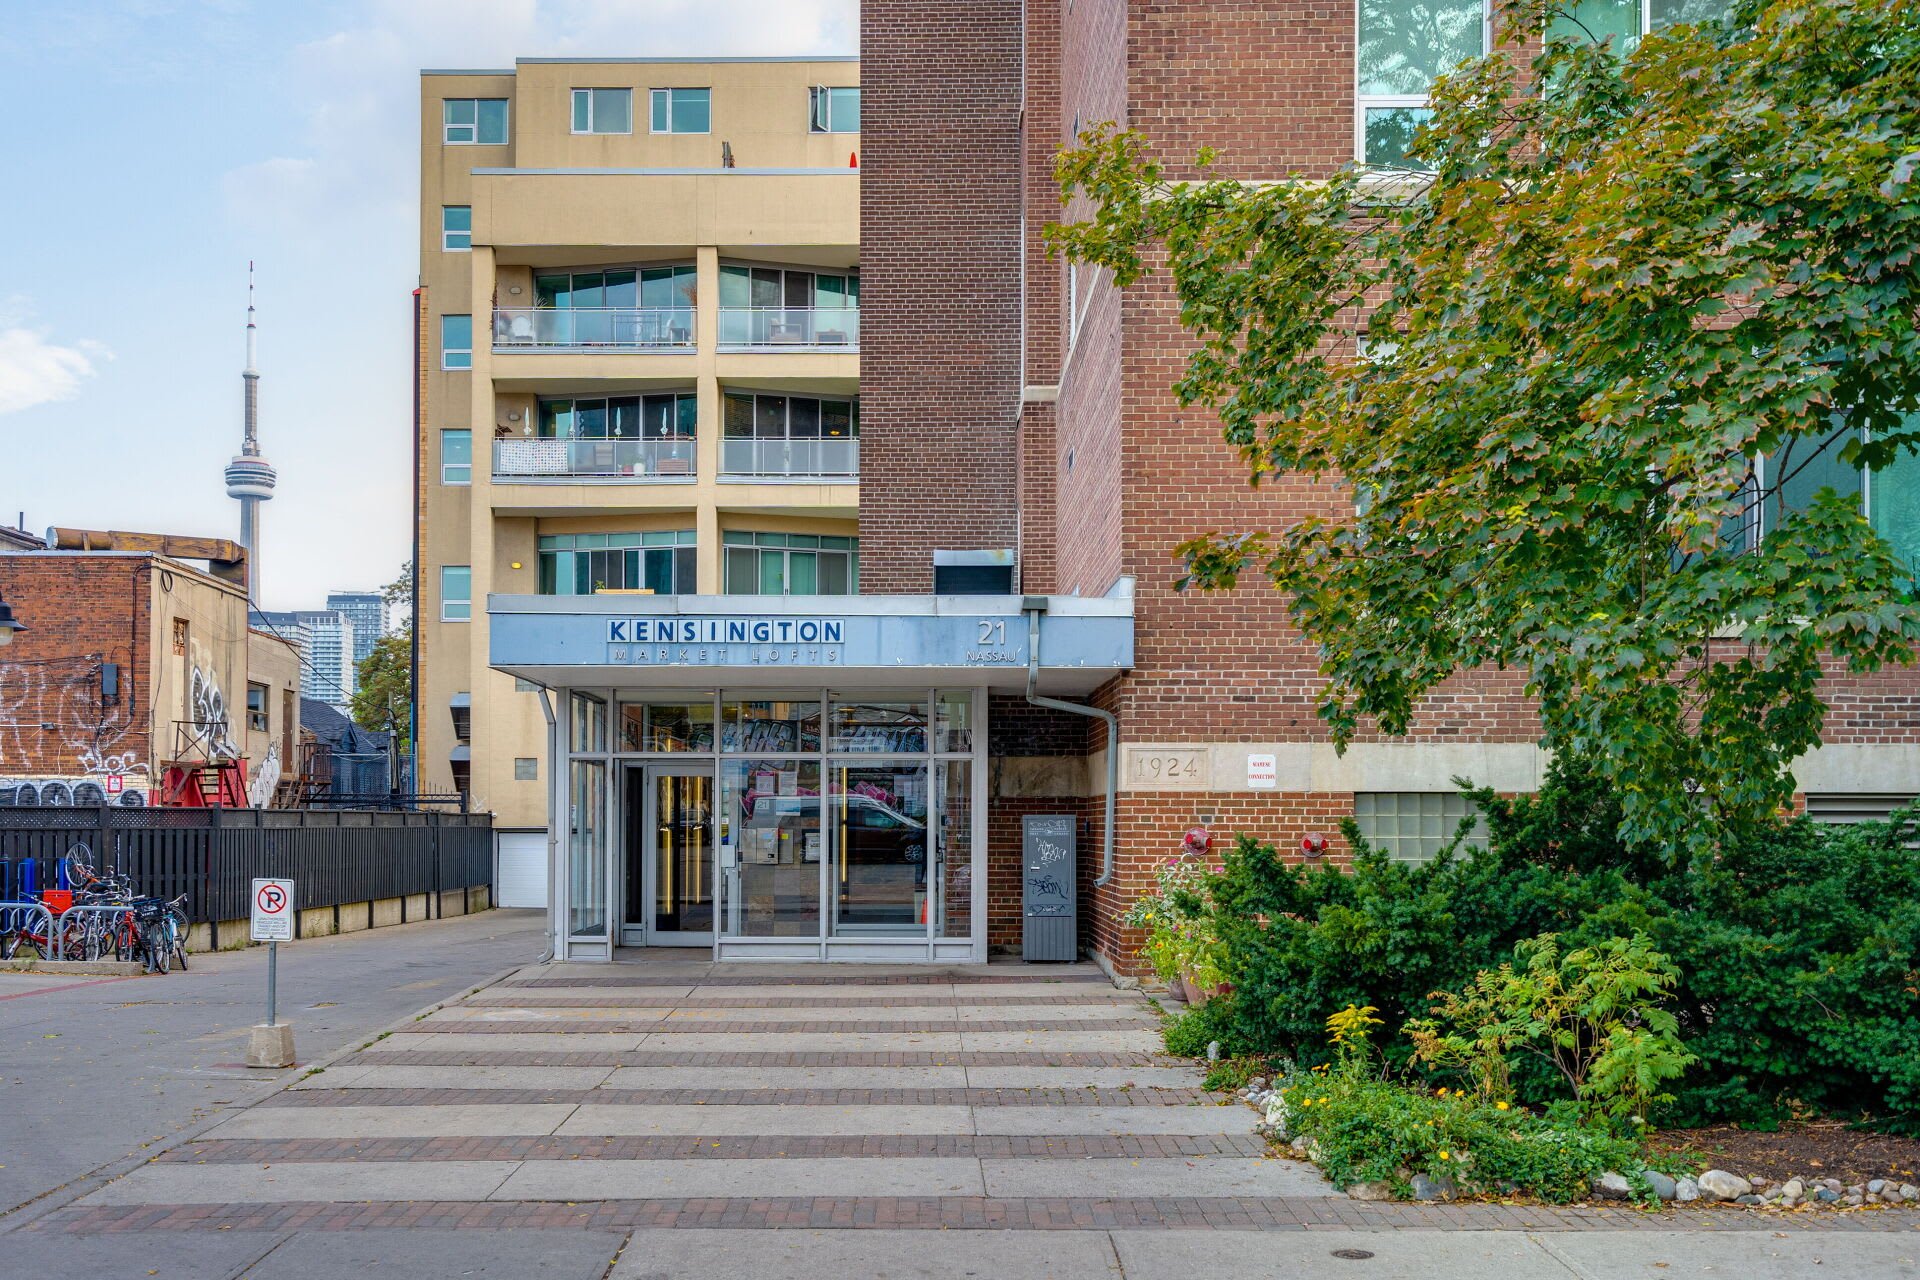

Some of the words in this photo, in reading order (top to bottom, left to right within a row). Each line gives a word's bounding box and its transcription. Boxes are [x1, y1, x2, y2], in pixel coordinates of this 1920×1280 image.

[610, 621, 842, 642] KENSINGTON
[977, 620, 1006, 645] 21
[615, 649, 727, 661] MARKET
[752, 649, 837, 661] LOFTS
[966, 650, 1016, 662] NASSAU
[1137, 757, 1197, 778] 1924
